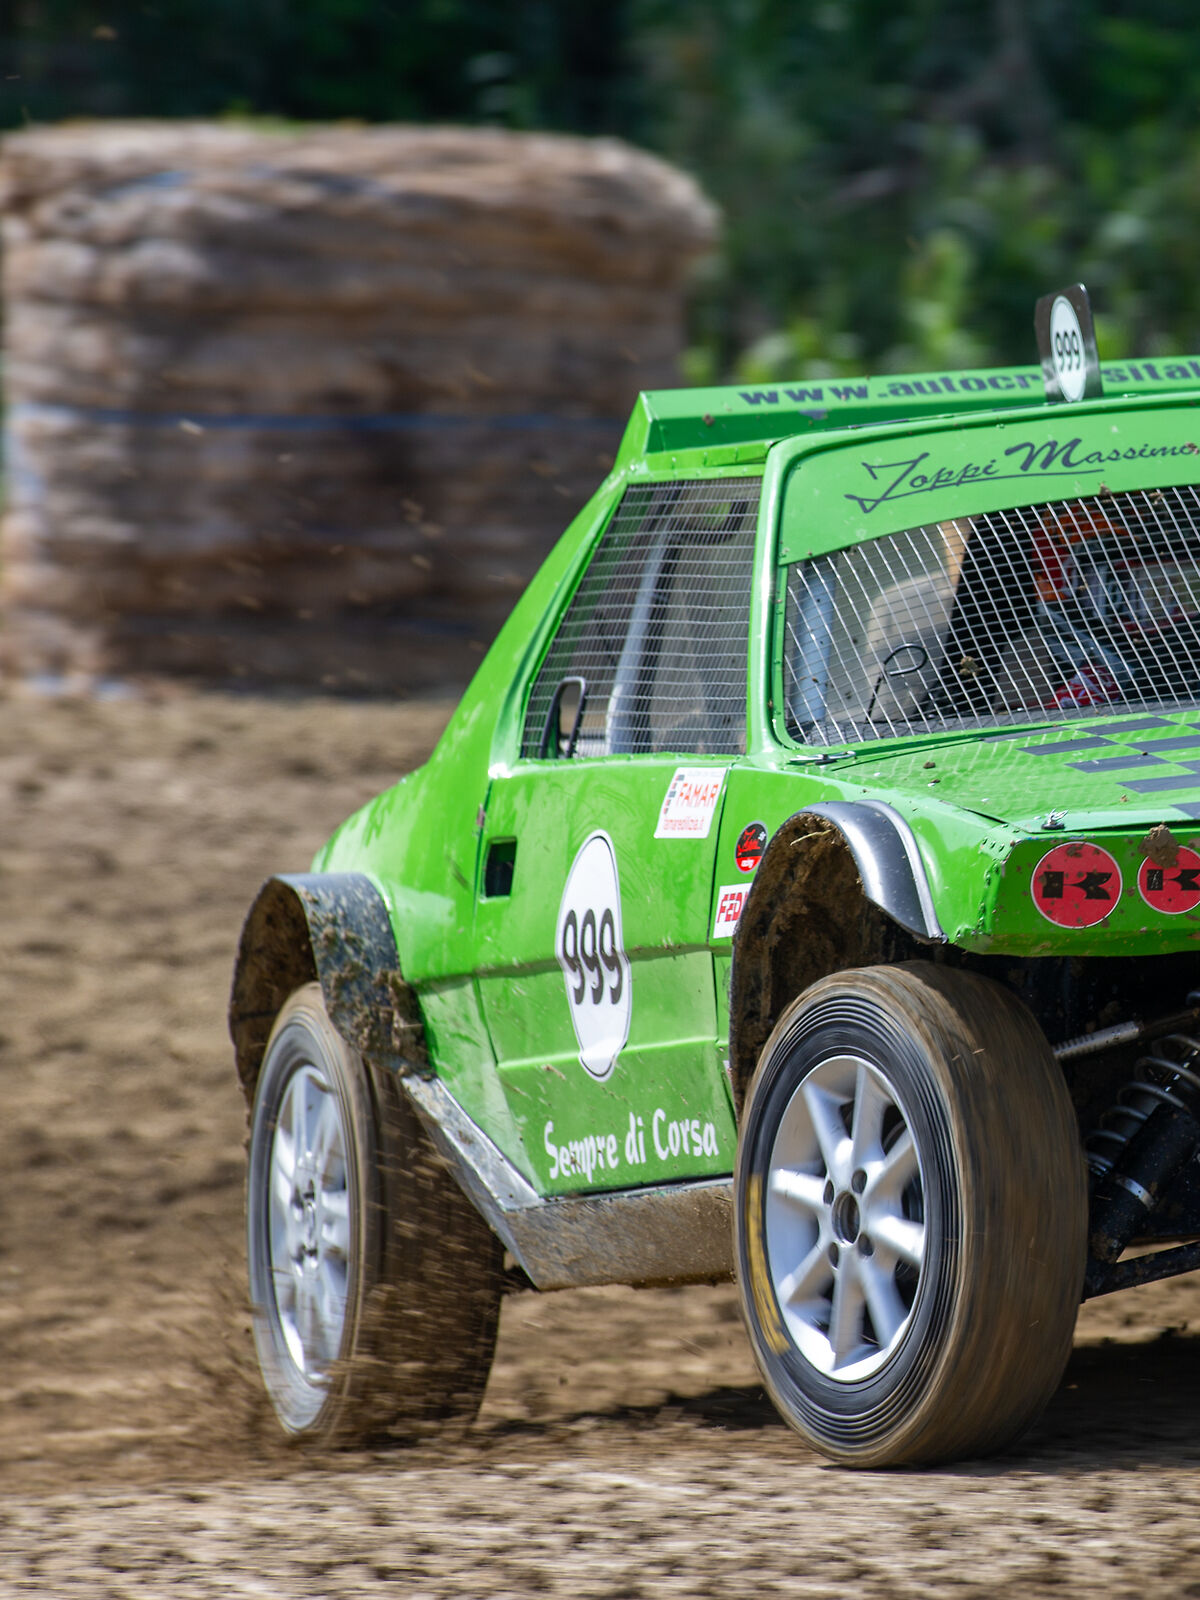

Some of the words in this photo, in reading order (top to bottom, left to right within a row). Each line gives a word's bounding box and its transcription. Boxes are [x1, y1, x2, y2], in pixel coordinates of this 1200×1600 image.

[1056, 330, 1080, 371] 999
[676, 783, 719, 807] FAMAR
[562, 908, 623, 1006] 999
[544, 1120, 619, 1184] Sempre
[625, 1111, 646, 1166] di
[652, 1108, 719, 1161] Corsa
